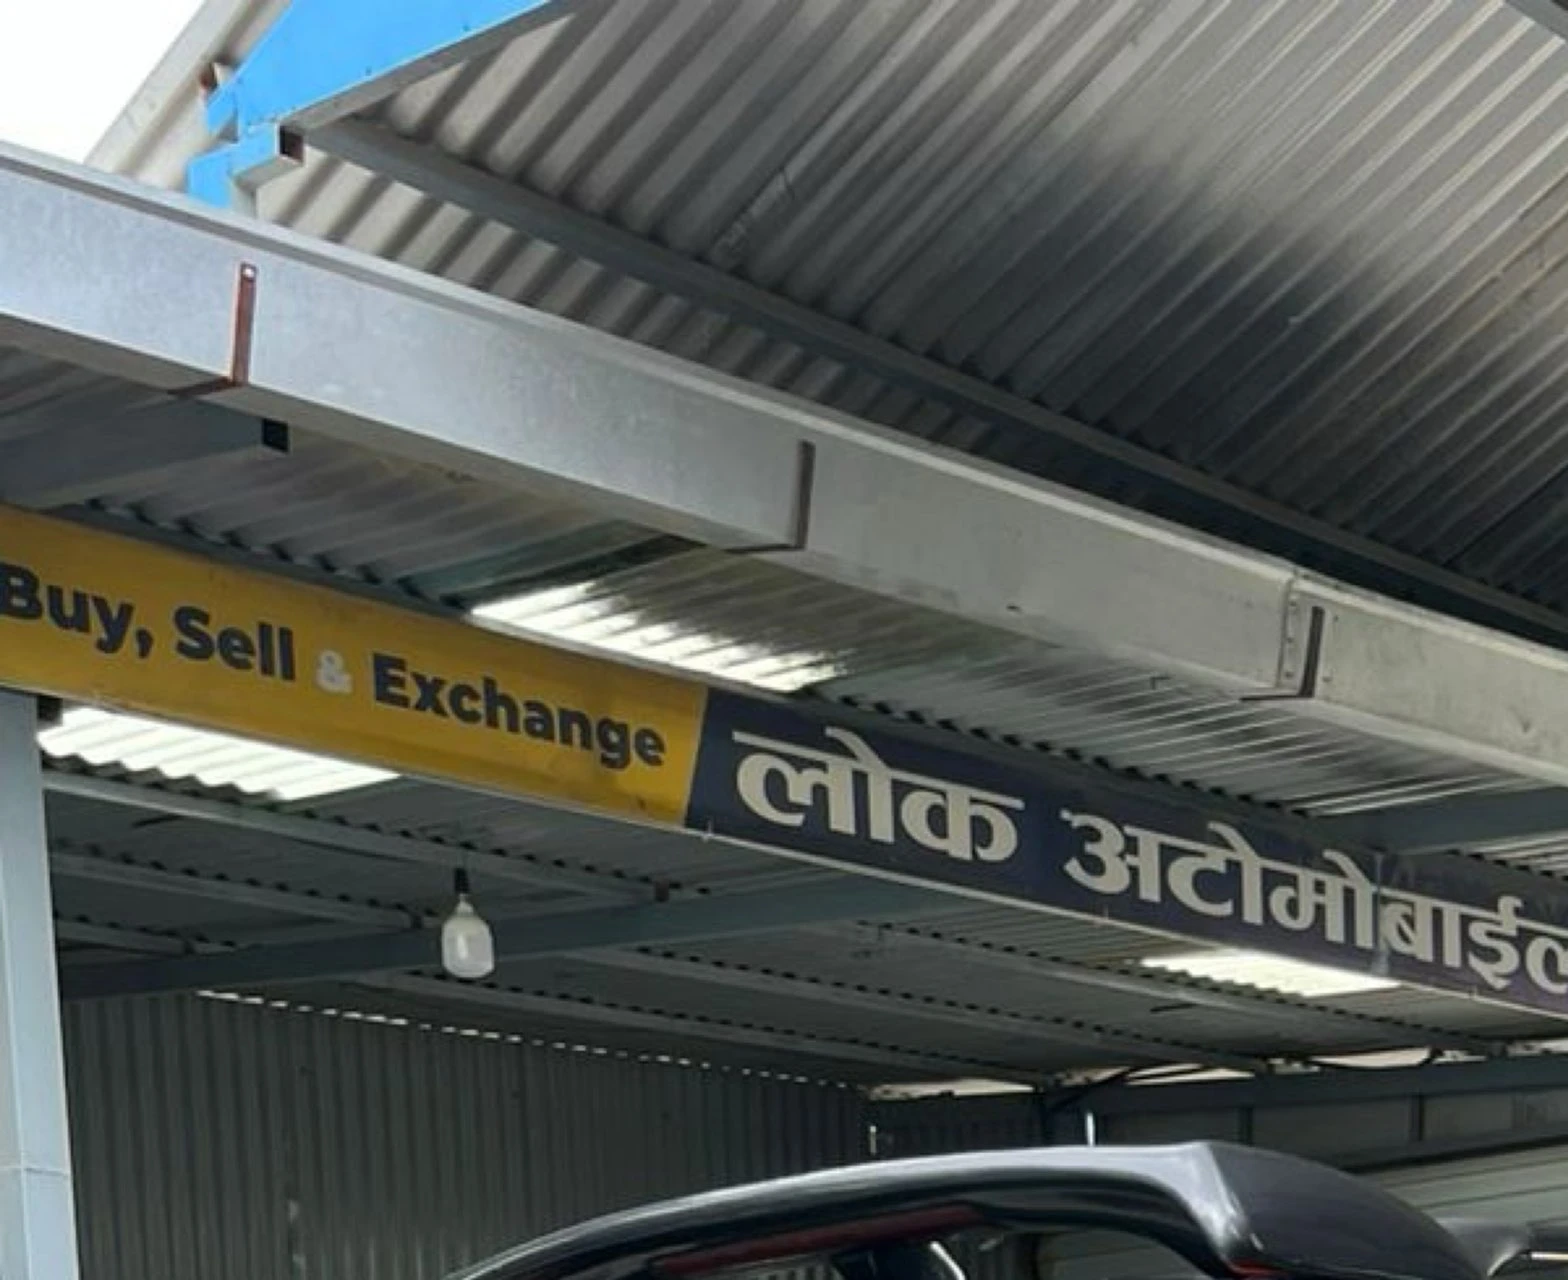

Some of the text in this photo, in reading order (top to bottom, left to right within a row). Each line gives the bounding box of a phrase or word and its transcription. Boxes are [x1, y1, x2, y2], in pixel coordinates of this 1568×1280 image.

[0, 562, 667, 770] Buy, Sell & Exchange
[733, 726, 1025, 861] लोक
